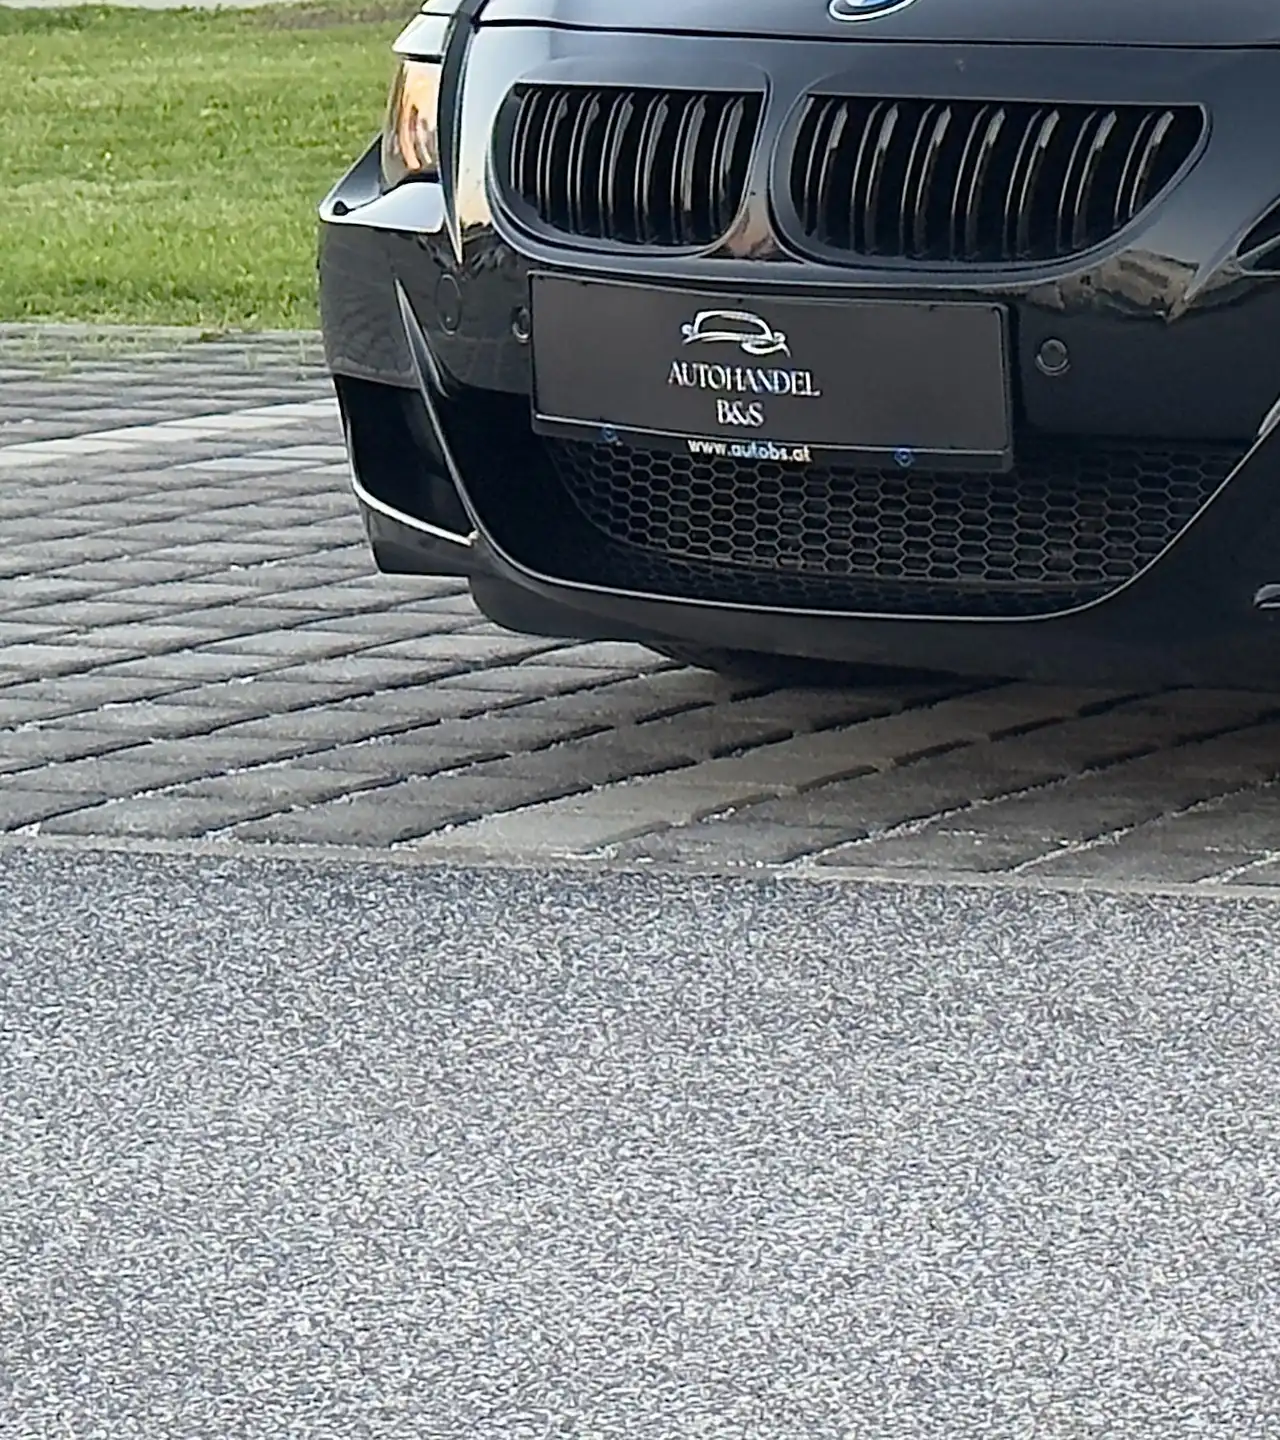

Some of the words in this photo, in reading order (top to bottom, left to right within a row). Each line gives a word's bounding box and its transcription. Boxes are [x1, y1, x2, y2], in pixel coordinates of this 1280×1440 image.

[668, 361, 821, 396] AUTOHANDEL
[716, 399, 764, 427] B&S
[687, 439, 812, 462] www.autobs.at
